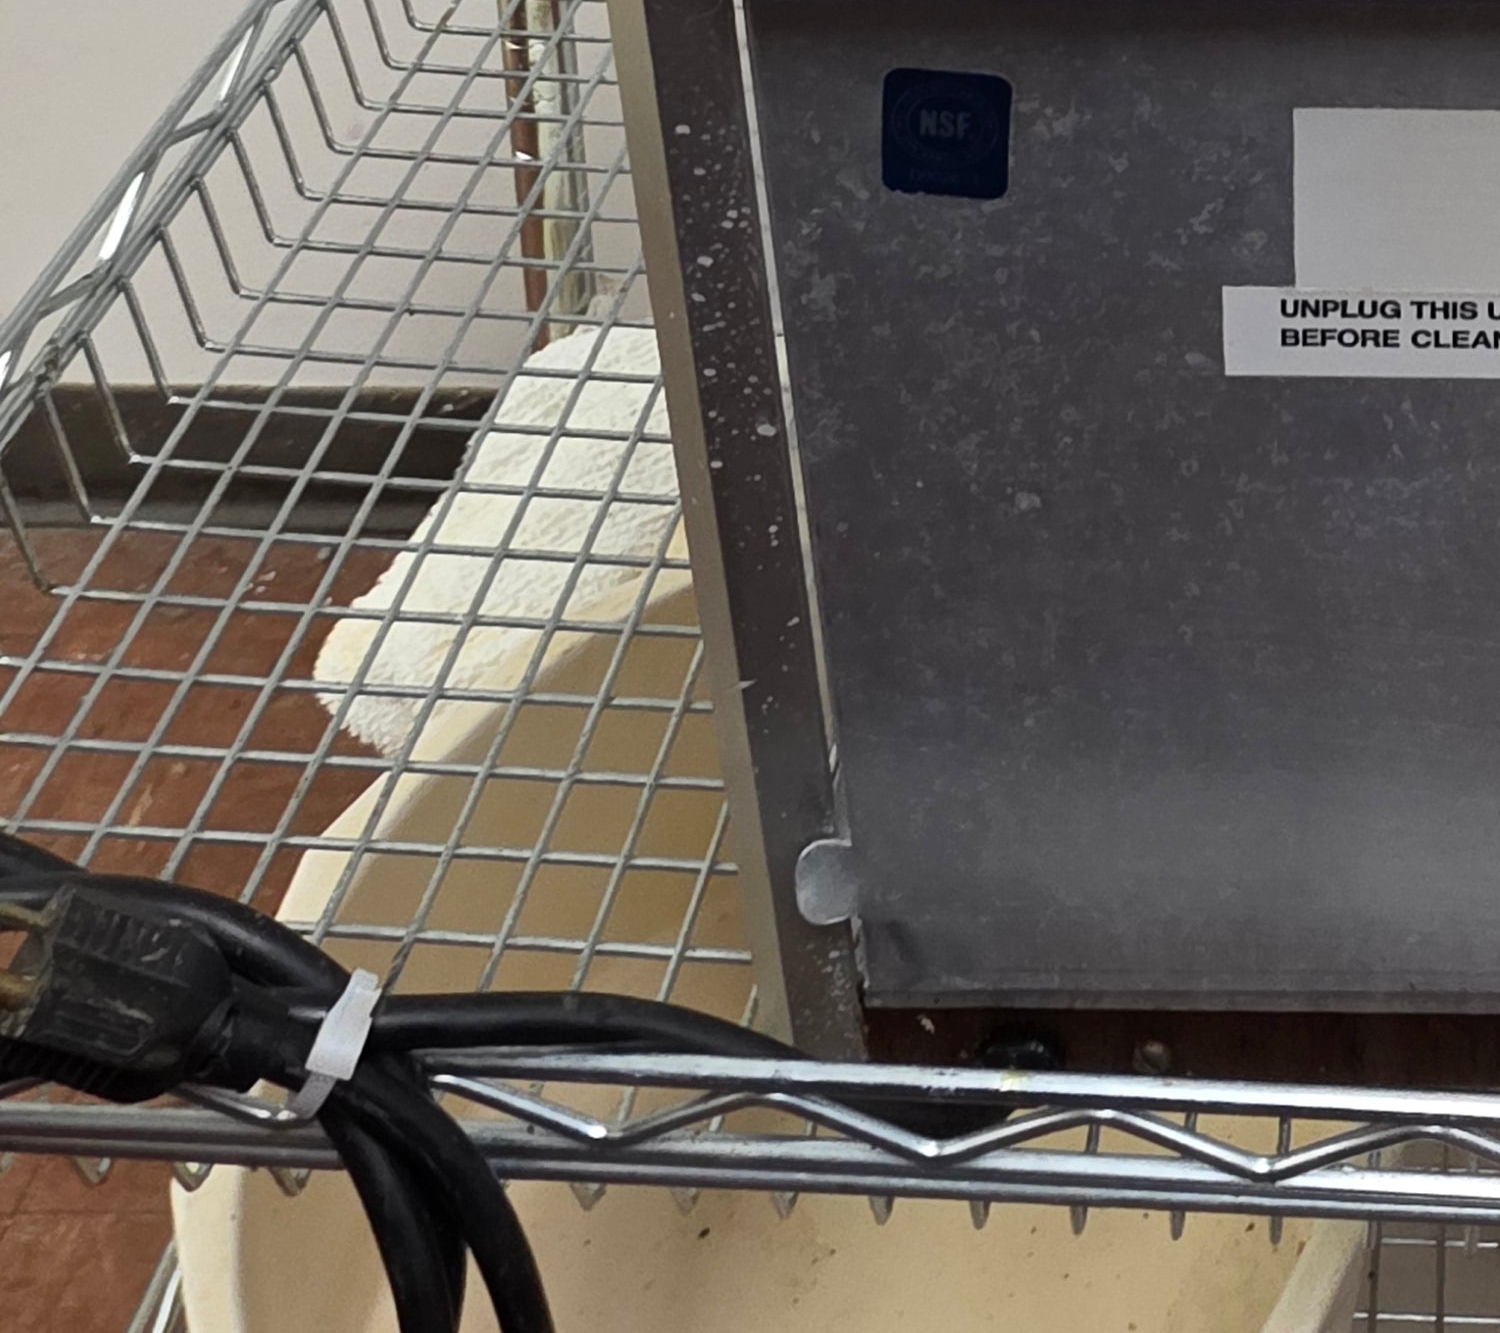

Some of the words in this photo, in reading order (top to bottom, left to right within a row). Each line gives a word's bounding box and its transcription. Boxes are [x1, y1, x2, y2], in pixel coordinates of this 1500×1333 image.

[919, 109, 972, 140] NSF
[1280, 299, 1401, 320] UNPLUG
[1410, 301, 1478, 321] THIS
[1280, 329, 1401, 348] BEFORE
